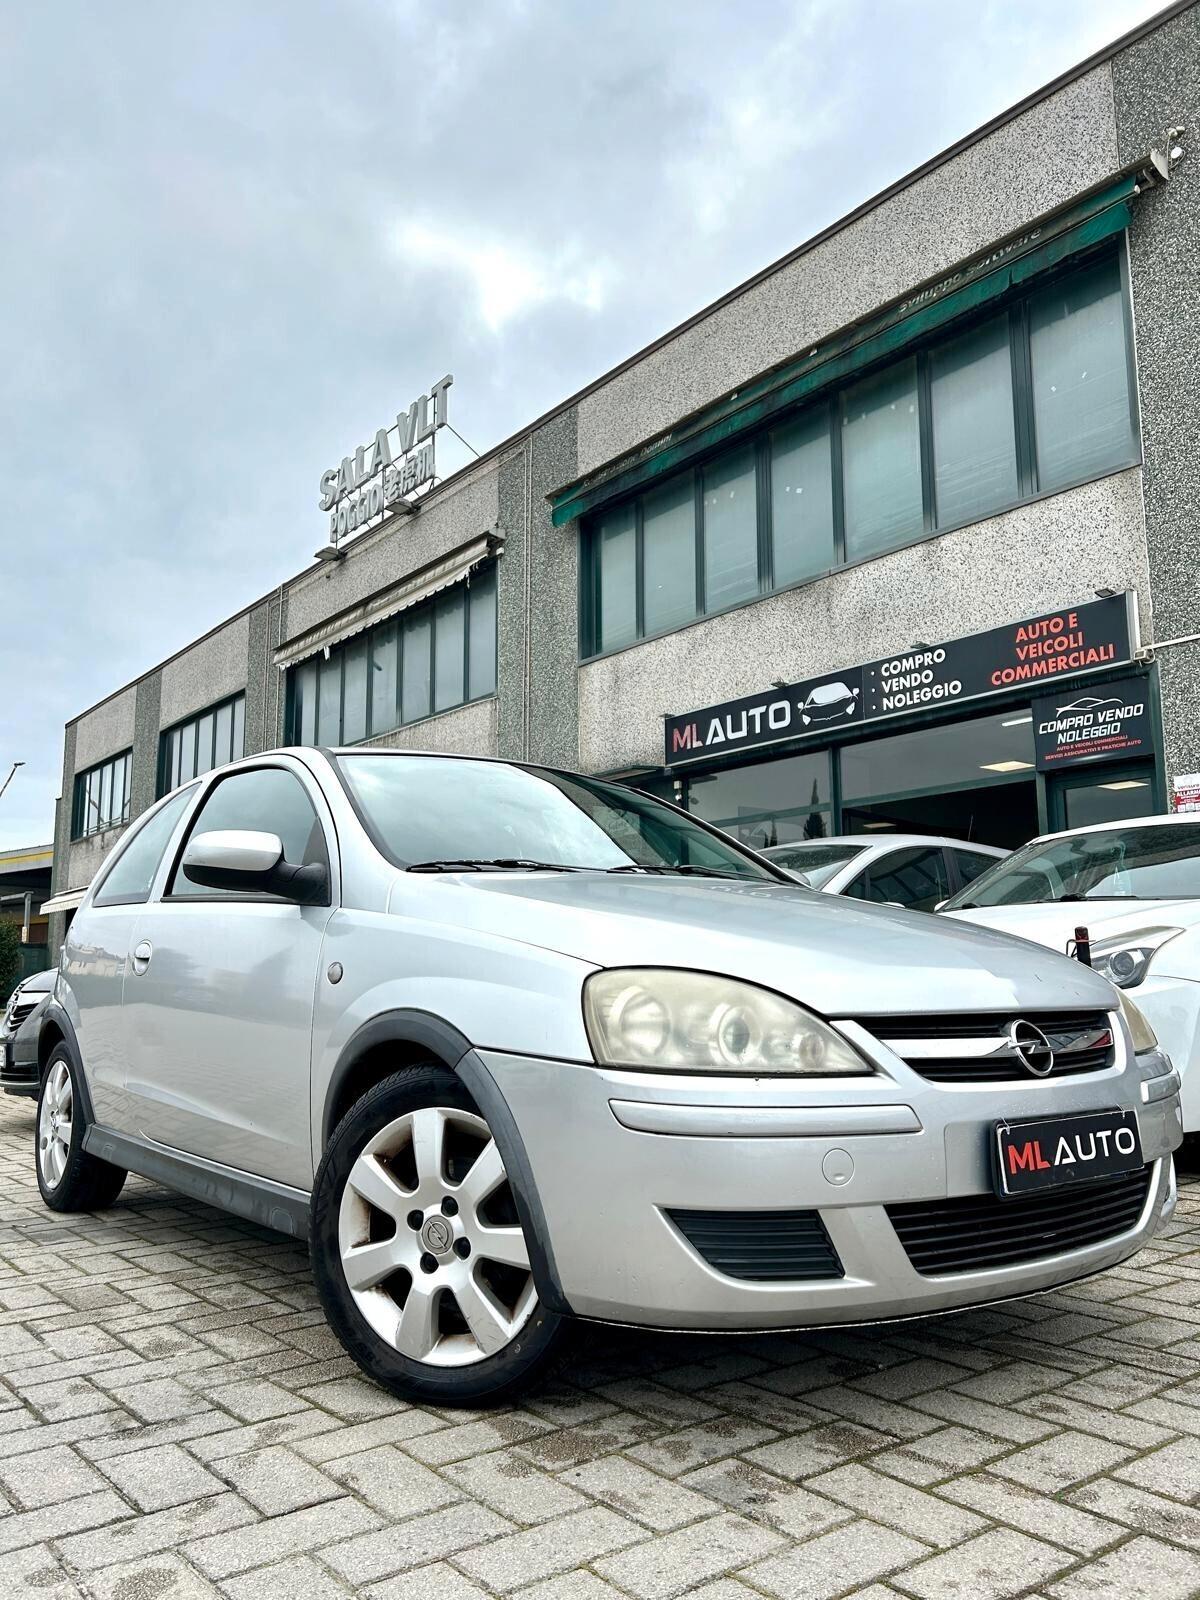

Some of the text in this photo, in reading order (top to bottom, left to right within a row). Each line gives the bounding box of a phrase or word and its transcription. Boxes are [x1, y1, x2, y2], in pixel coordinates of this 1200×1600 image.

[319, 374, 454, 511] SALA VLT
[330, 483, 384, 543] POGGIO
[1015, 612, 1078, 644] AUTO E
[1016, 631, 1084, 661] VEICOLI
[881, 648, 946, 677] COMPRO
[990, 643, 1115, 686] COMMERCIALI
[881, 670, 934, 694] VENDO
[882, 680, 962, 711] NOLEGGIO
[1039, 703, 1144, 735] COMPRO VENDO
[1057, 722, 1121, 744] NOLEGGIO
